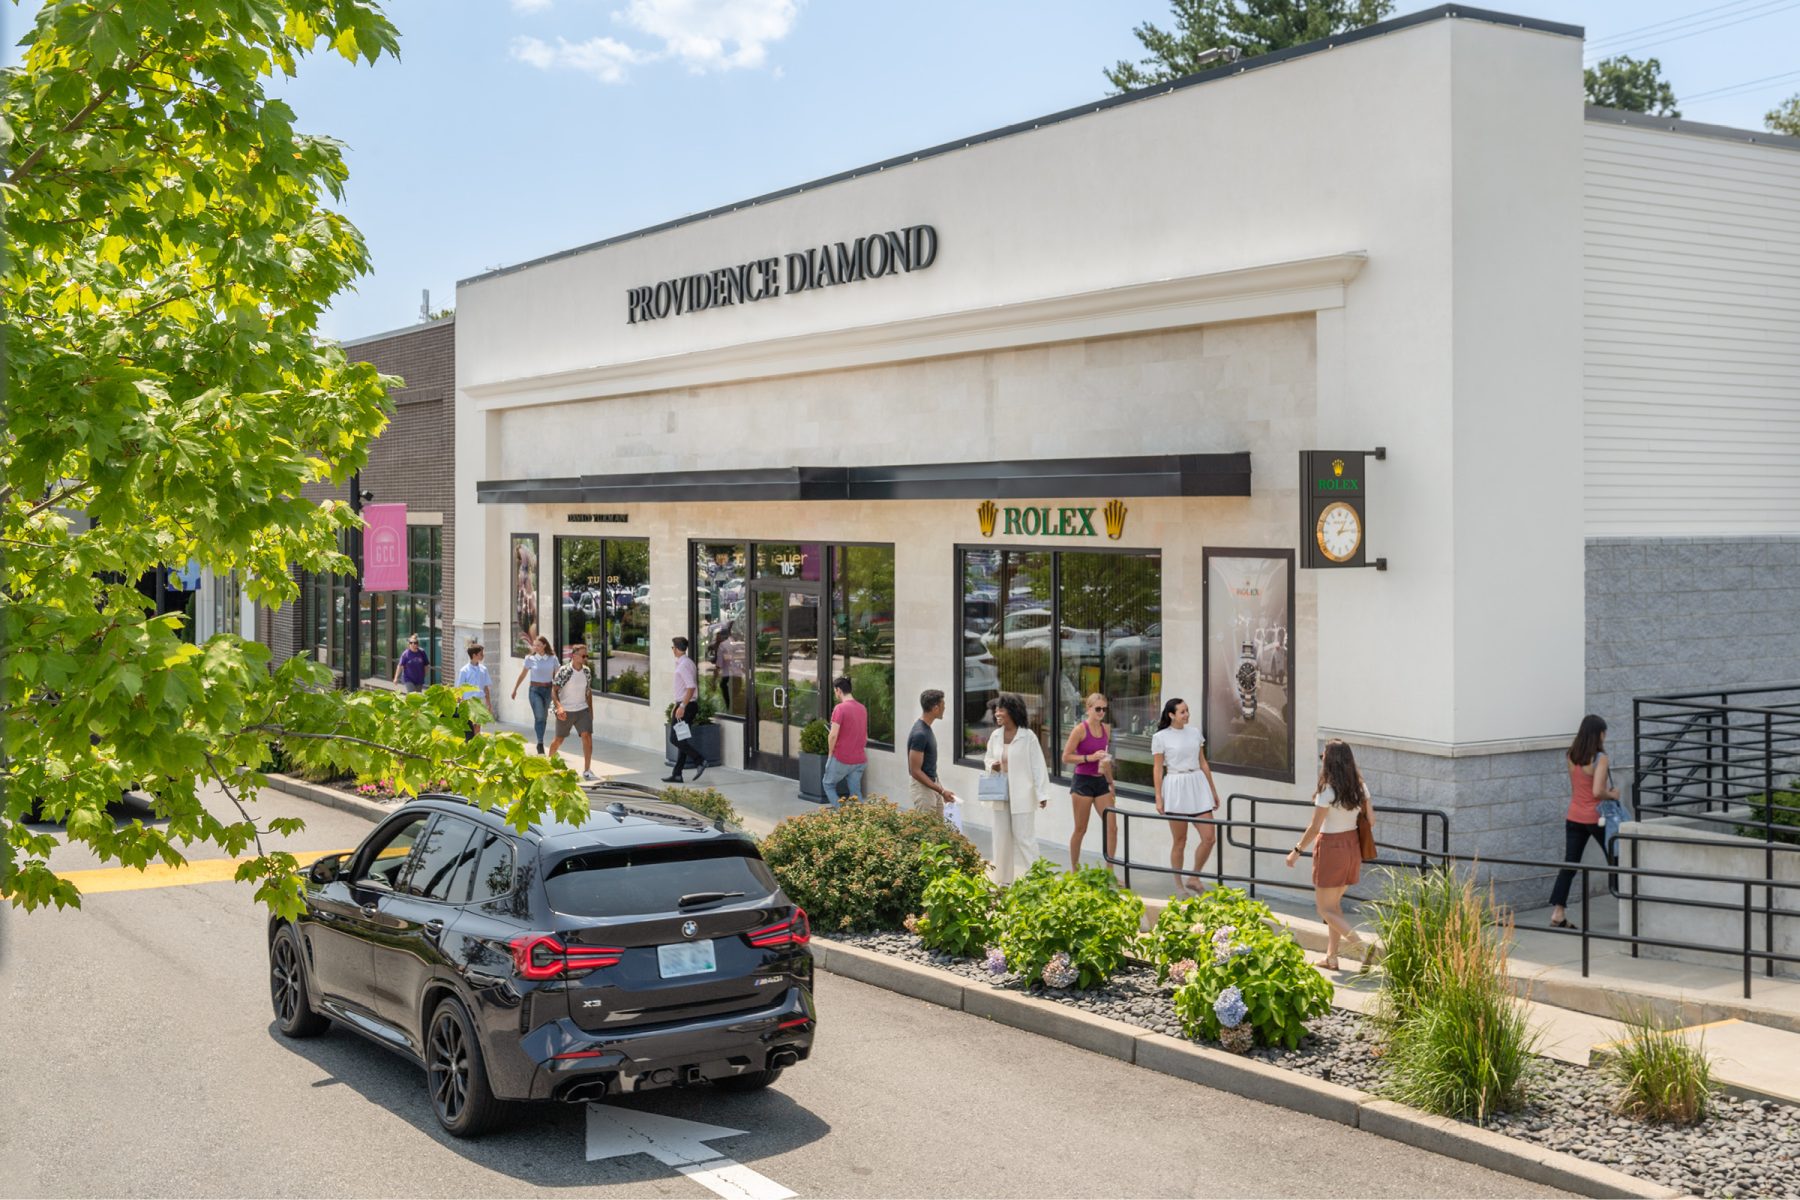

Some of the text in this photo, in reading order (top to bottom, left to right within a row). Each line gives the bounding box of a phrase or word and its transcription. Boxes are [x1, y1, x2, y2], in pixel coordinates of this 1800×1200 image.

[626, 224, 938, 324] PROVIDENCE DIAMOND
[1318, 479, 1359, 491] ROLEX
[1003, 506, 1098, 536] ROLEX
[781, 562, 795, 576] 105
[587, 575, 620, 585] TUOR
[583, 1000, 602, 1008] X3
